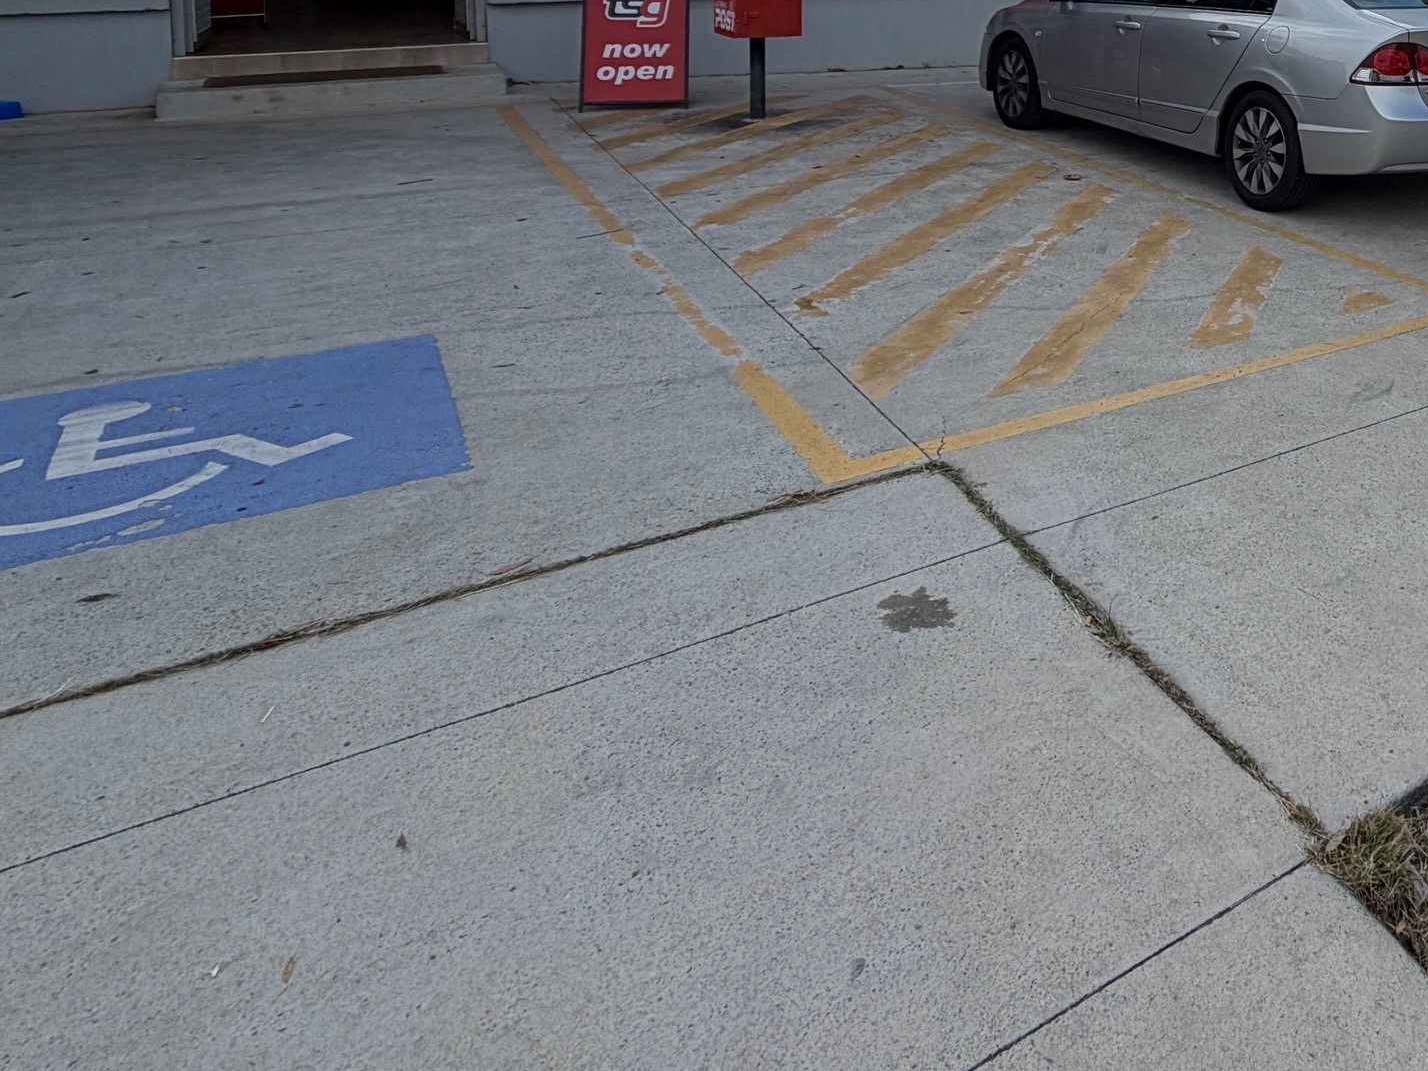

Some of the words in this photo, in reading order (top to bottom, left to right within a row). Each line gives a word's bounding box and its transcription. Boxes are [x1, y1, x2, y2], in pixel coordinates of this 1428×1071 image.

[715, 7, 736, 32] POST
[602, 43, 671, 59] now
[597, 65, 675, 86] open
